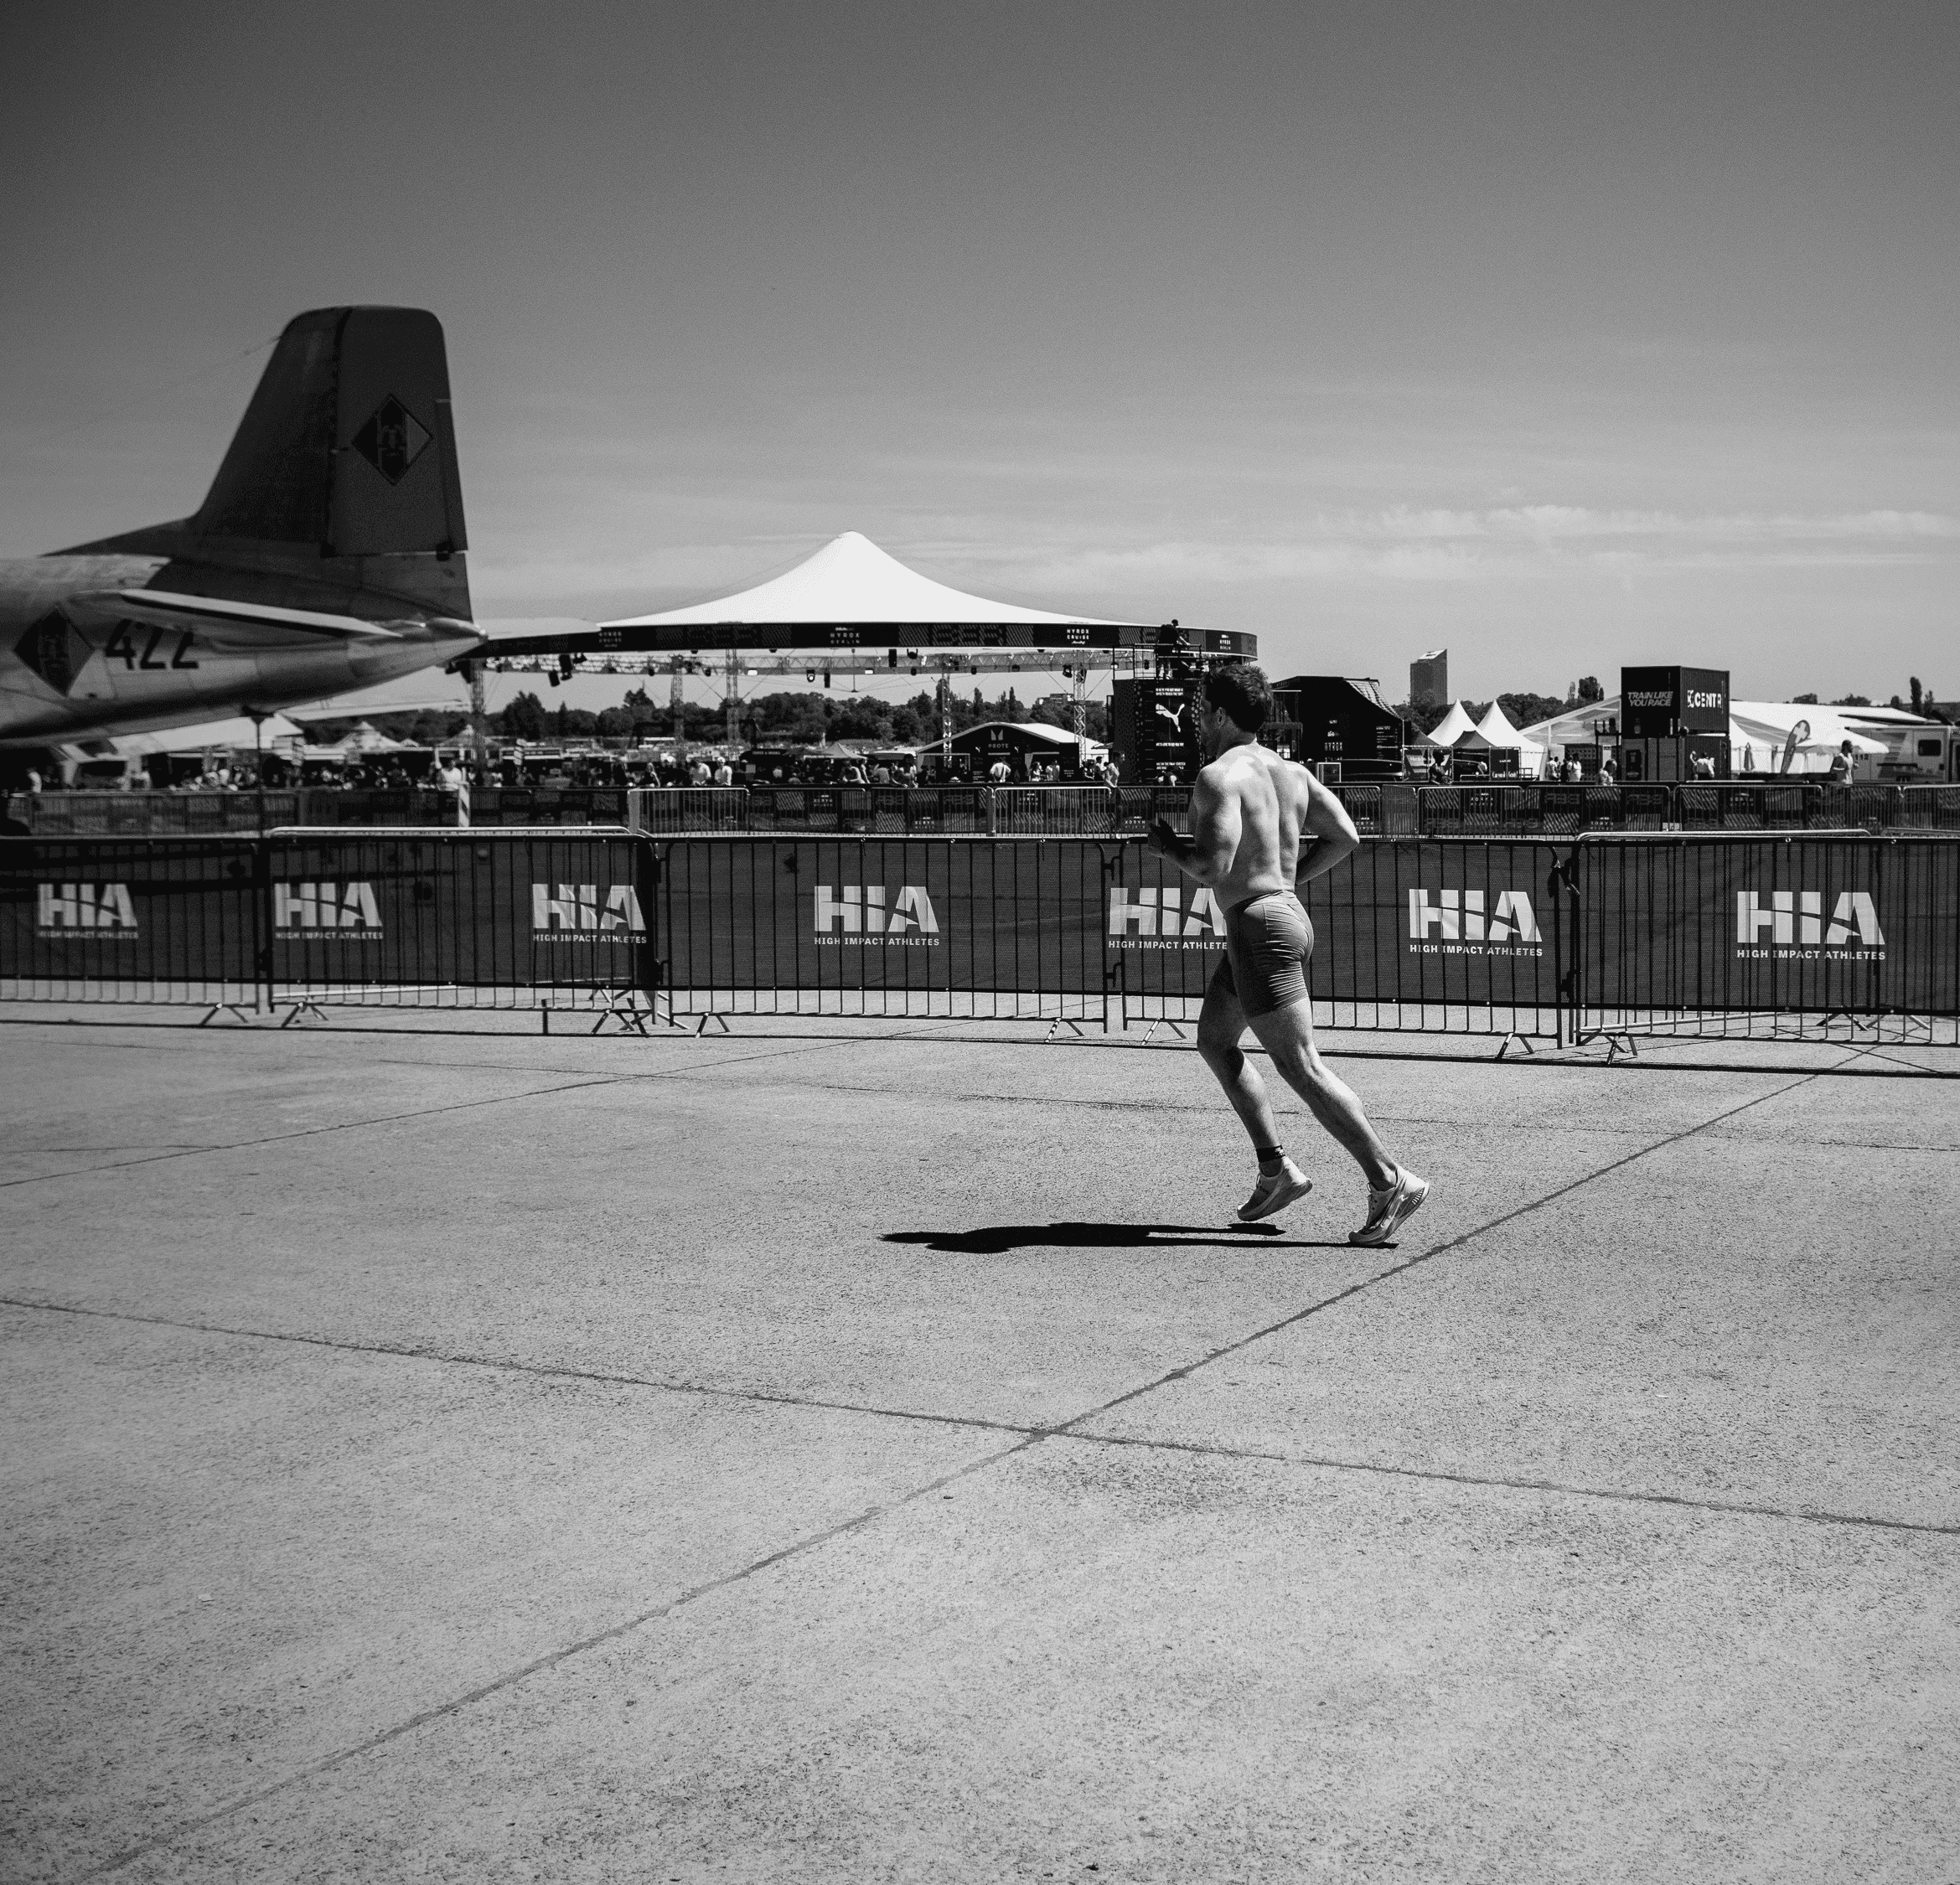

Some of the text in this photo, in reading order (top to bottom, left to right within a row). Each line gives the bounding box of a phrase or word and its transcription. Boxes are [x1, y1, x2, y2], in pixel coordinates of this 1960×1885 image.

[1627, 691, 1673, 700] TRAIN LIKE
[1629, 699, 1671, 707] YOU RACE
[39, 884, 137, 927] HIA
[275, 882, 383, 927] HIA
[532, 884, 646, 930] HIA
[814, 886, 939, 932] HIA
[1109, 888, 1228, 936] HIA
[1409, 889, 1543, 942] HIA
[1737, 891, 1885, 945] HIA
[560, 934, 597, 942] IMPACT
[600, 935, 647, 943] ATHLETES
[814, 937, 940, 947] HIGH IMPACT ATHLETES
[1108, 940, 1228, 951] HIGH IMPACT ATHLETE
[1409, 944, 1543, 957] HIGH IMPACT ATHLETES
[1737, 949, 1886, 960] HIGH IMPACT ATHLETES
